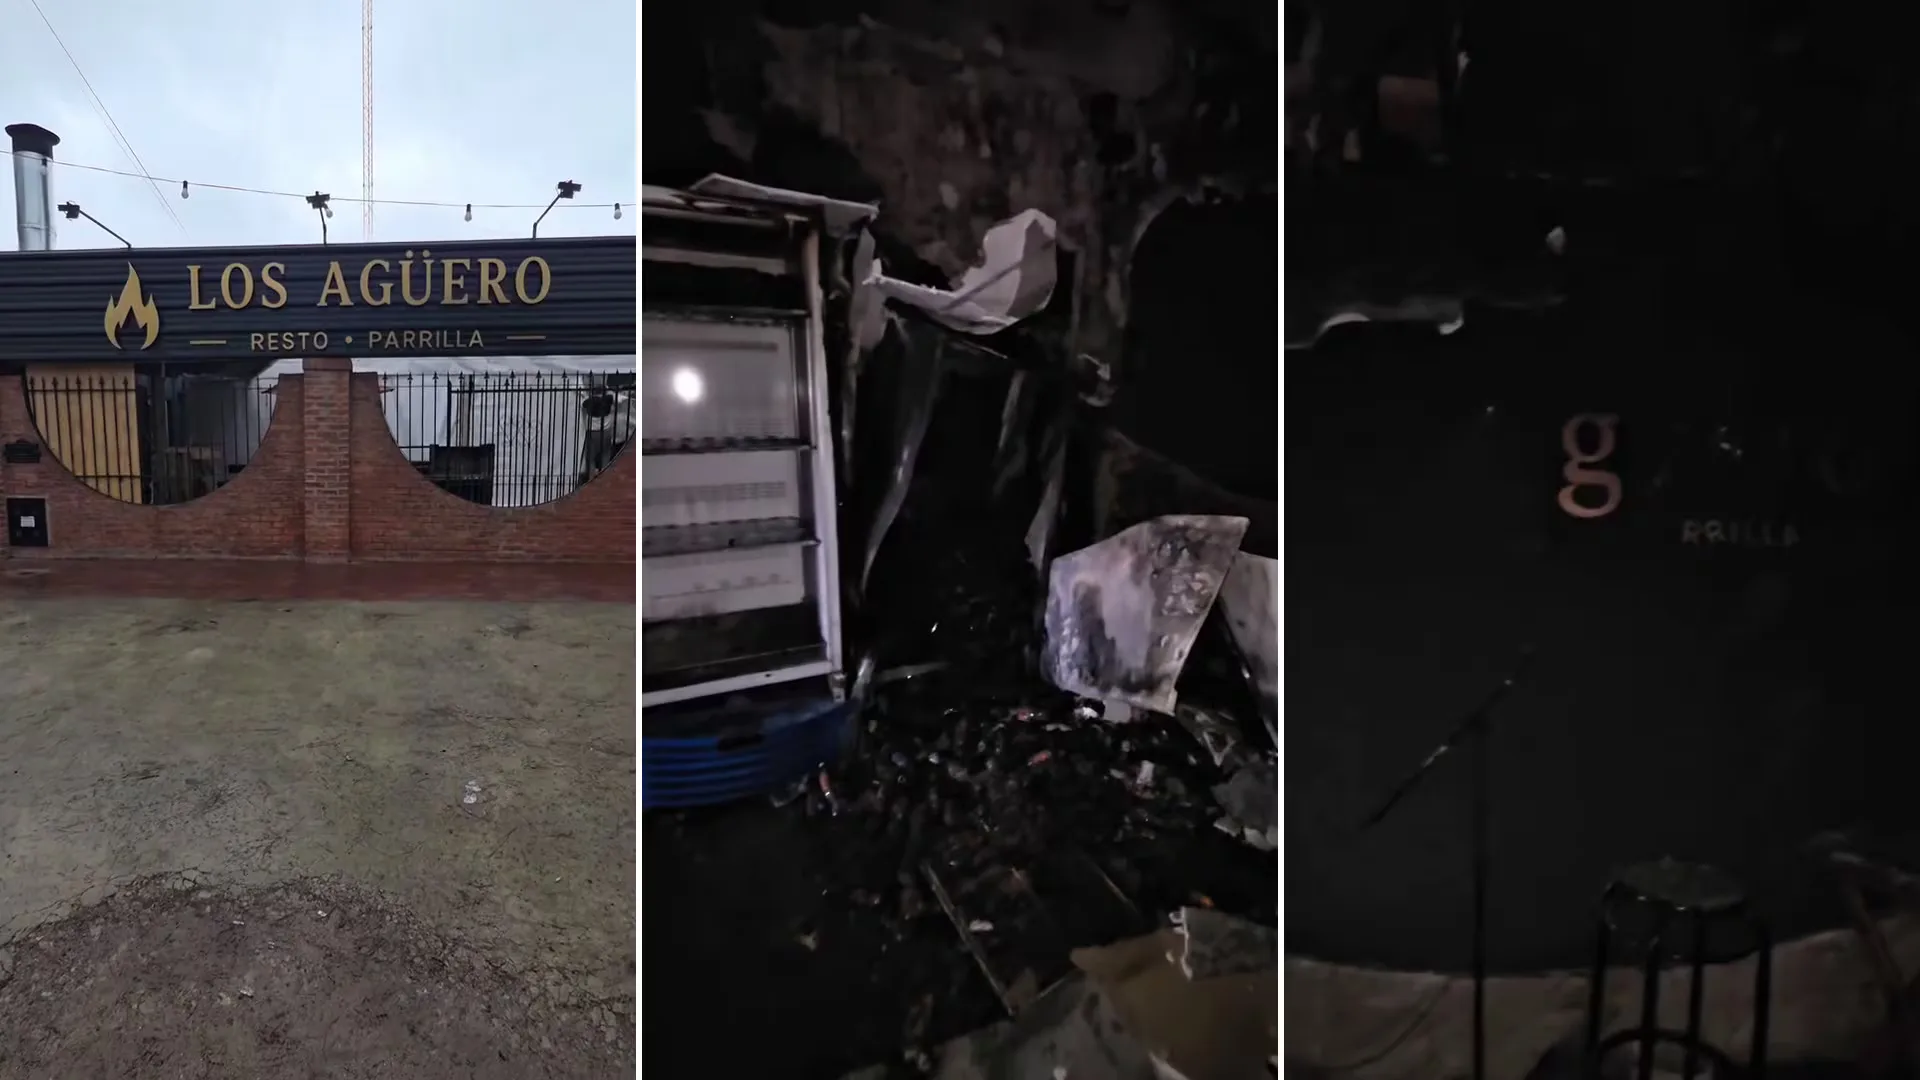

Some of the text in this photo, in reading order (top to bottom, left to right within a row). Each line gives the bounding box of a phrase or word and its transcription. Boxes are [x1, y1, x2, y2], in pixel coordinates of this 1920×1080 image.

[187, 250, 552, 309] LOS AGÜERO
[250, 329, 484, 351] RESTO PARRILLA
[1557, 412, 1623, 518] g
